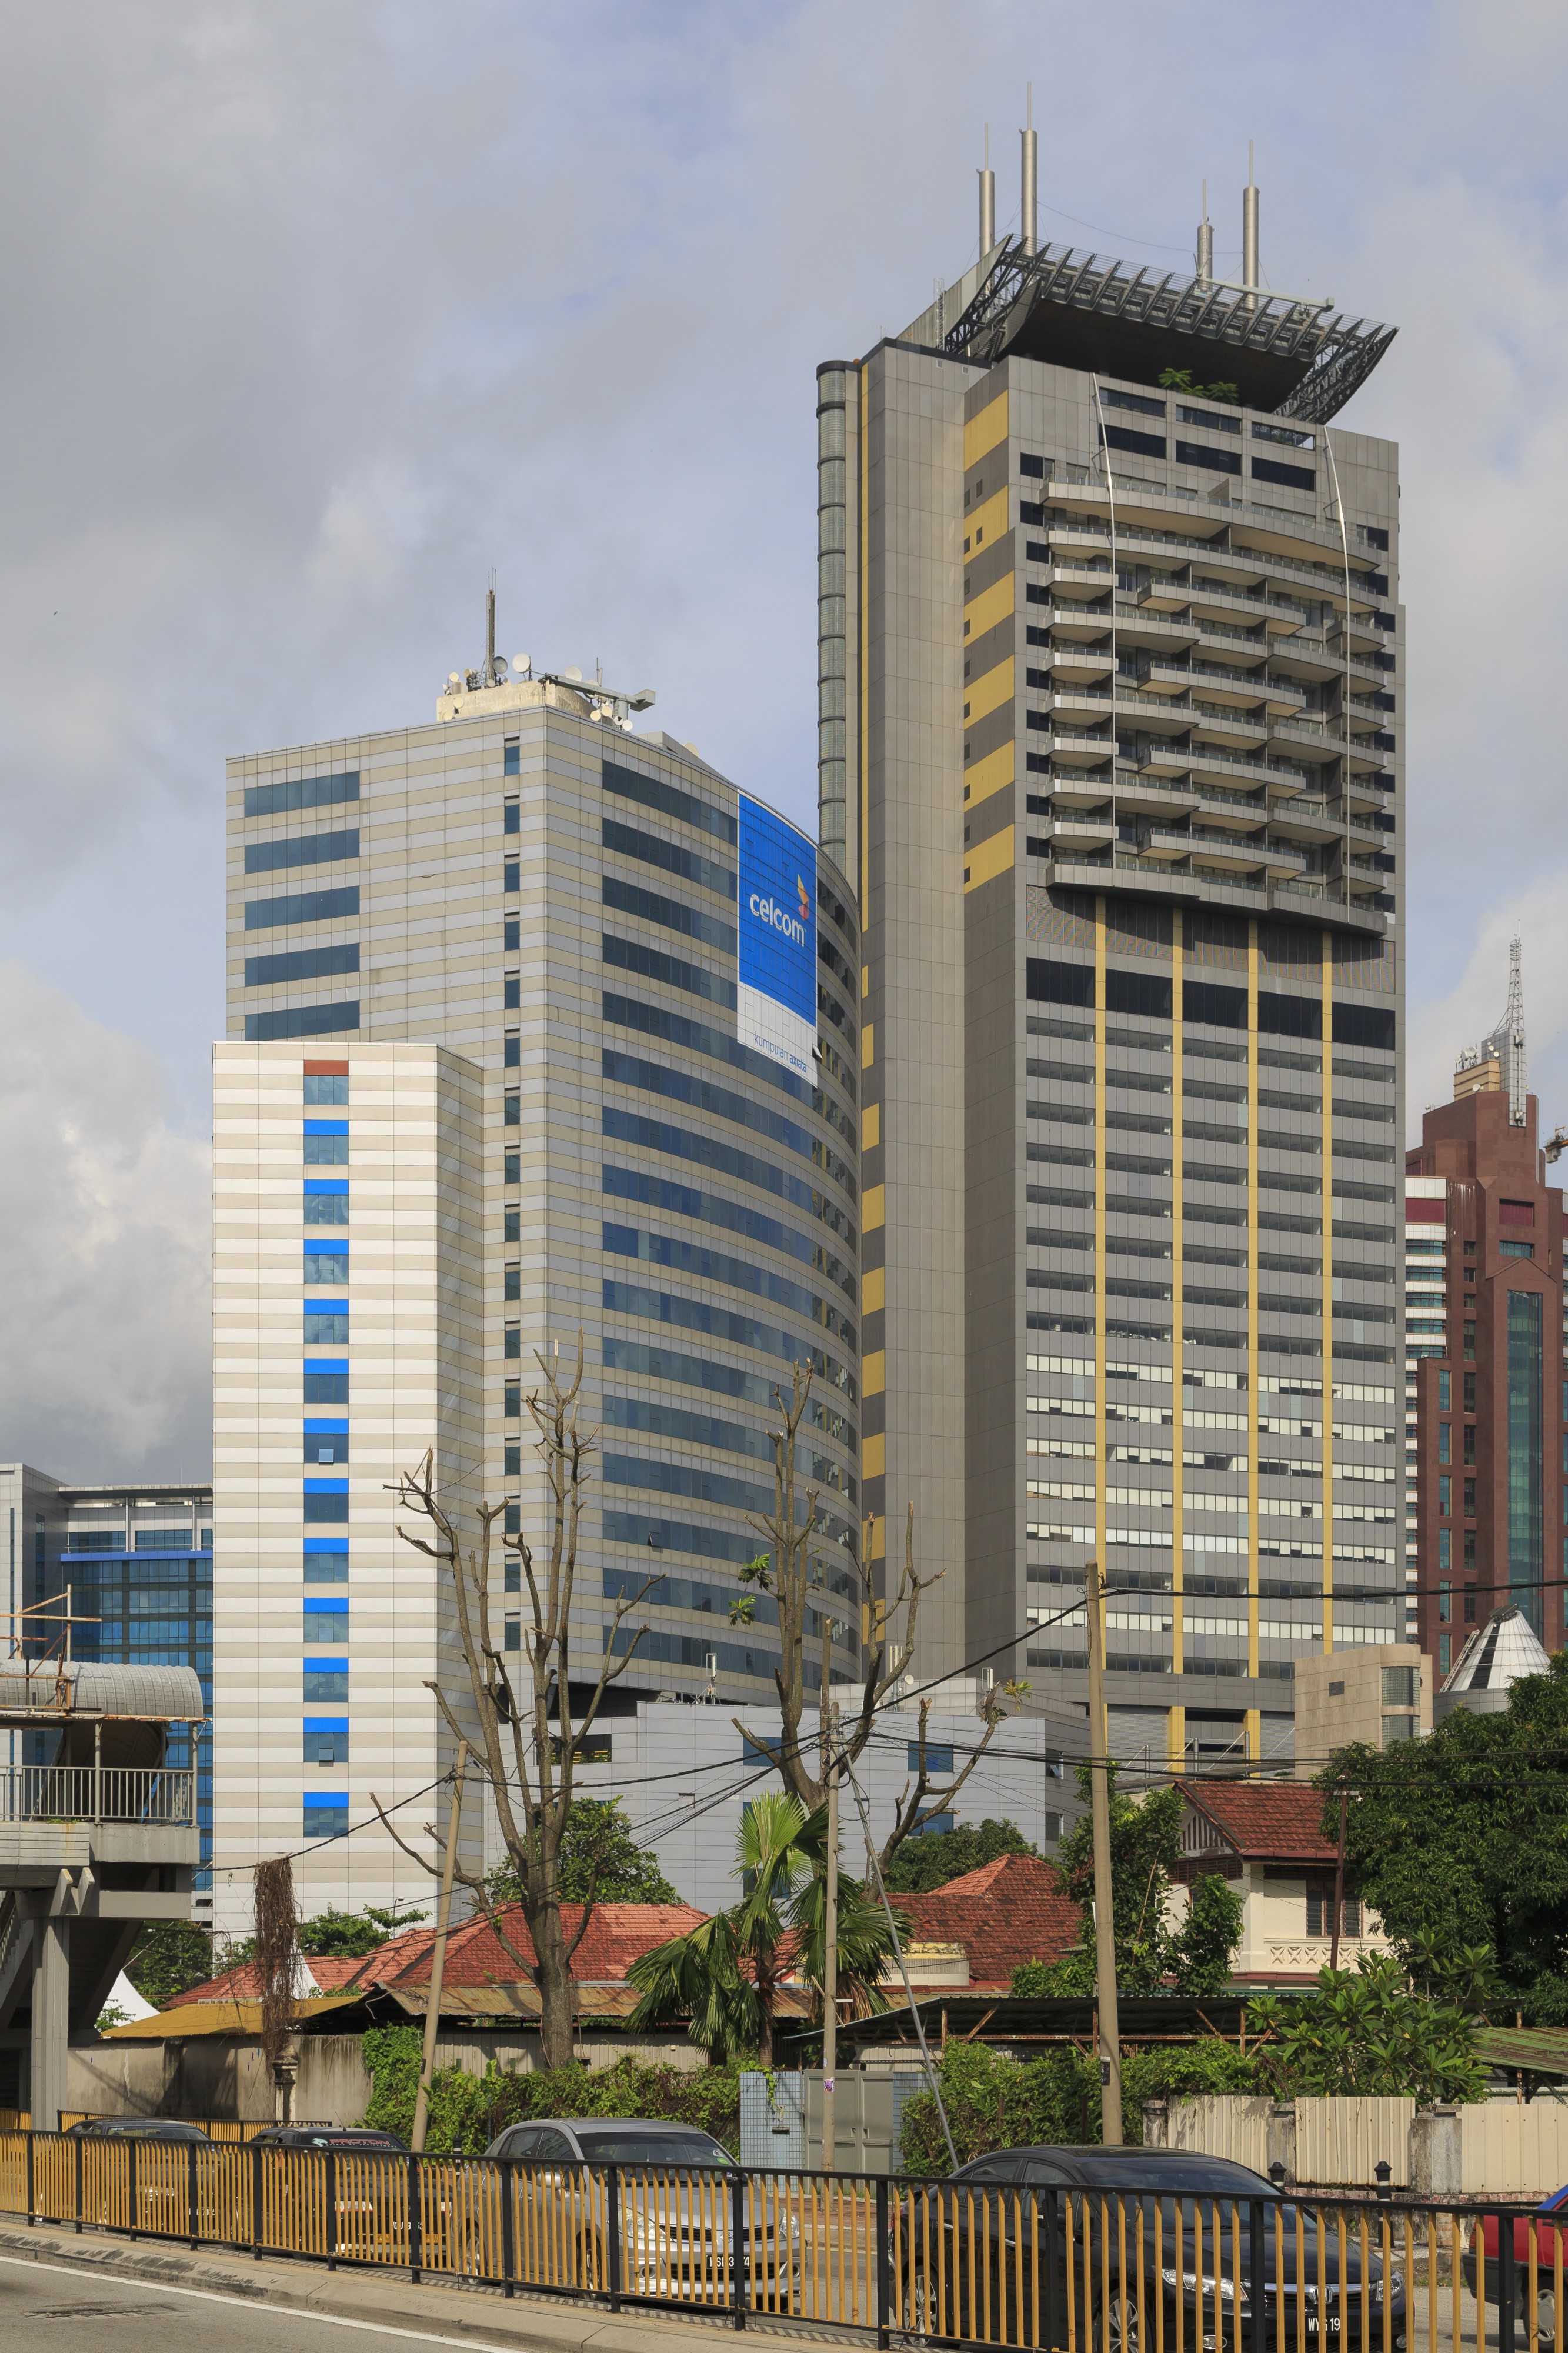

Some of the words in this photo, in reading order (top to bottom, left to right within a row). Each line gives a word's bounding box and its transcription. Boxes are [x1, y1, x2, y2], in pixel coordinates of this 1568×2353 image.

[750, 894, 805, 948] celcom
[754, 1031, 788, 1061] kumpulan
[789, 1054, 806, 1073] axiata
